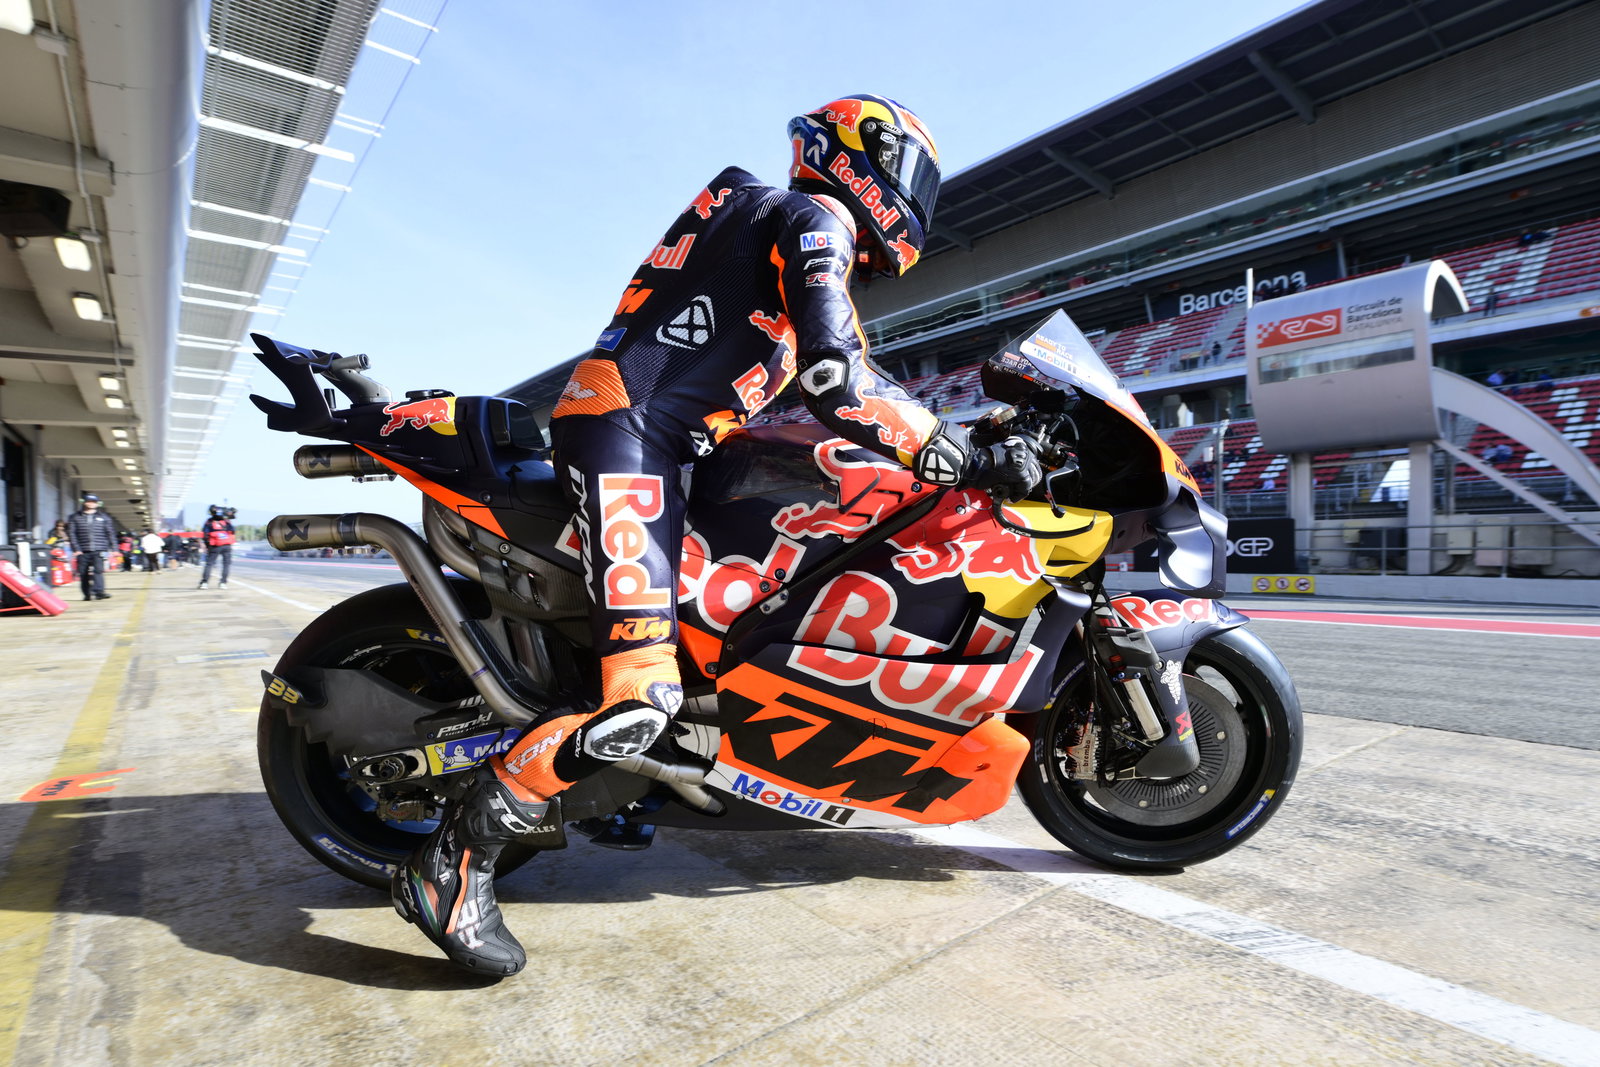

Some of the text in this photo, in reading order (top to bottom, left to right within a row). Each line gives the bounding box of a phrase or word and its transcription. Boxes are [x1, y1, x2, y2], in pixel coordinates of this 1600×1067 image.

[828, 151, 901, 232] Red Bull
[1179, 270, 1308, 316] Barceona
[1346, 296, 1403, 314] Circuit de
[1346, 307, 1403, 324] Barcelona
[1036, 334, 1056, 346] READY
[1037, 349, 1067, 370] Mobil
[1056, 350, 1073, 360] RACE
[598, 473, 671, 610] Red
[1109, 596, 1212, 631] Red
[609, 617, 671, 640] KTM
[786, 570, 1044, 726] Bull
[267, 677, 299, 704] 33
[717, 688, 973, 813] KTM
[1083, 739, 1091, 767] brembo
[731, 773, 823, 817] Mobil
